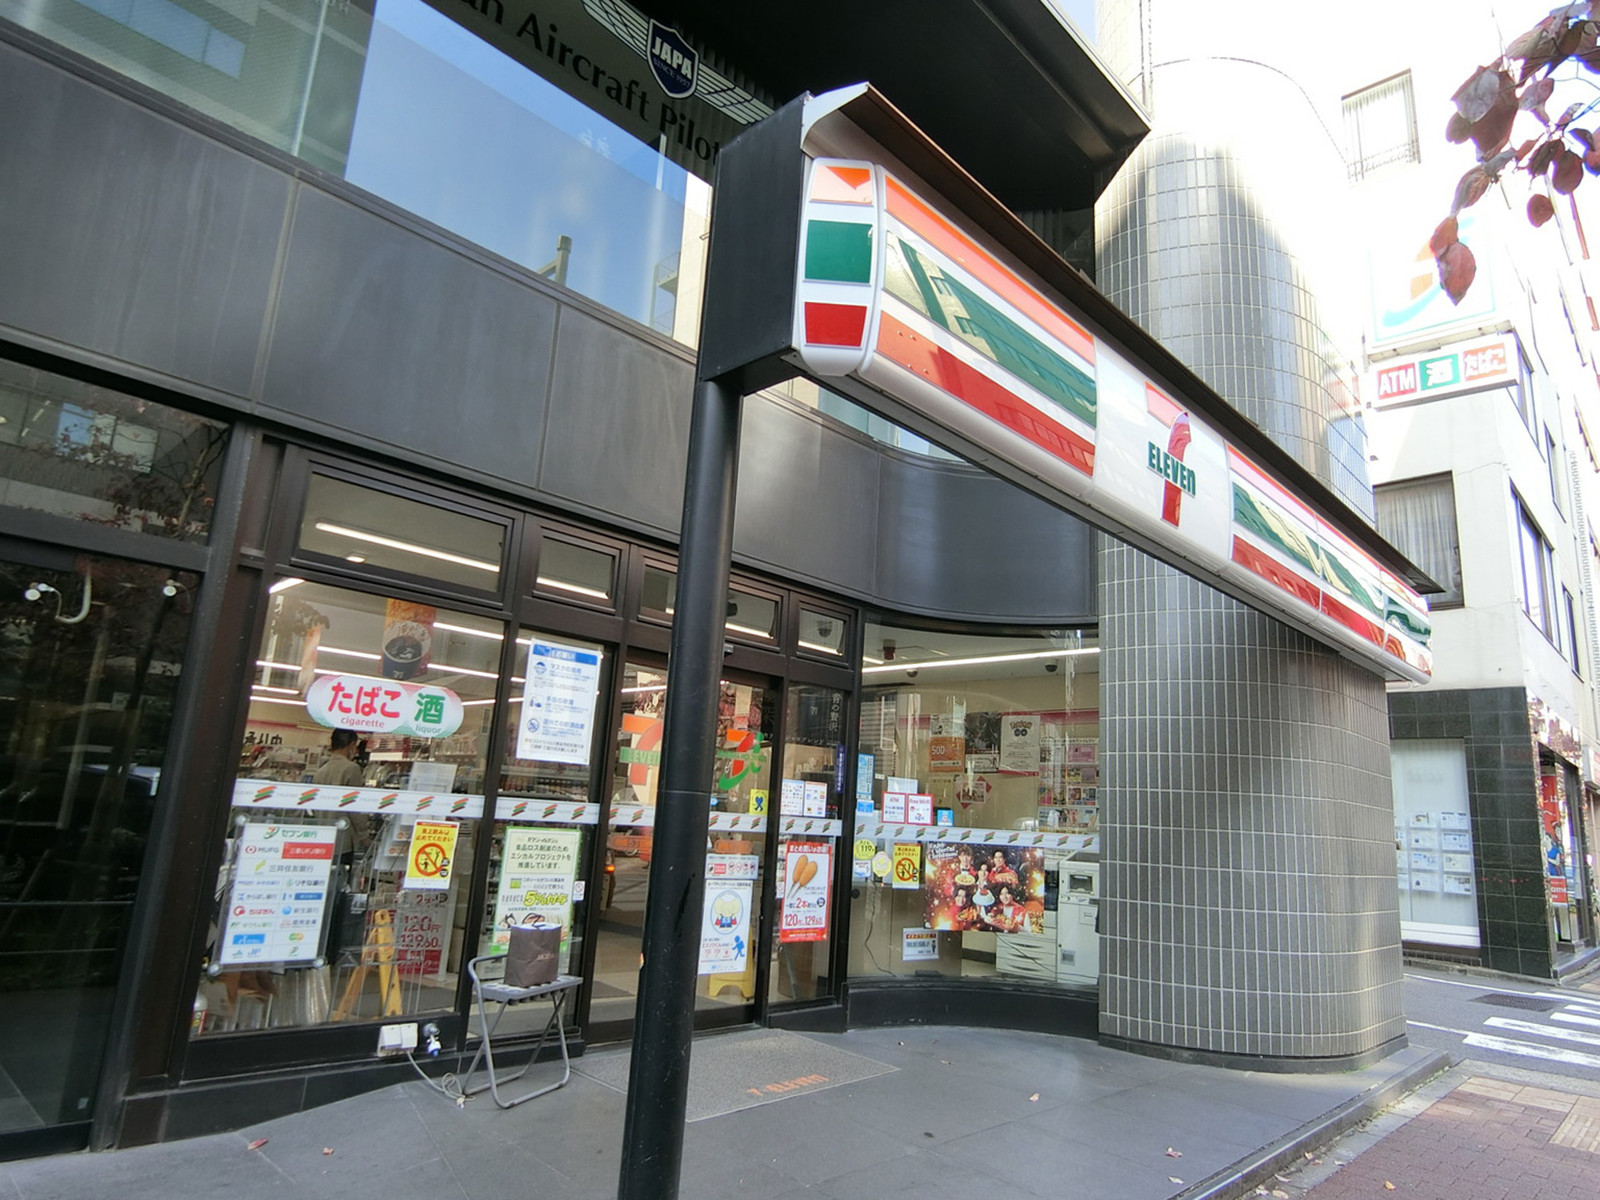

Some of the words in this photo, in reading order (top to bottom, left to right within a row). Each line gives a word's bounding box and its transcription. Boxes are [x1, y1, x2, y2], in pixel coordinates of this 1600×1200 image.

[516, 12, 650, 123] Aircraft
[652, 36, 693, 80] JAPA
[1379, 367, 1416, 397] ATM
[1463, 348, 1507, 378] たばこ
[328, 682, 401, 718] たばこ
[414, 692, 446, 724] 酒
[340, 716, 386, 729] cigarette
[415, 725, 442, 735] liquor
[281, 829, 318, 839] セブン銀行
[269, 864, 314, 873] 三井住友銀行
